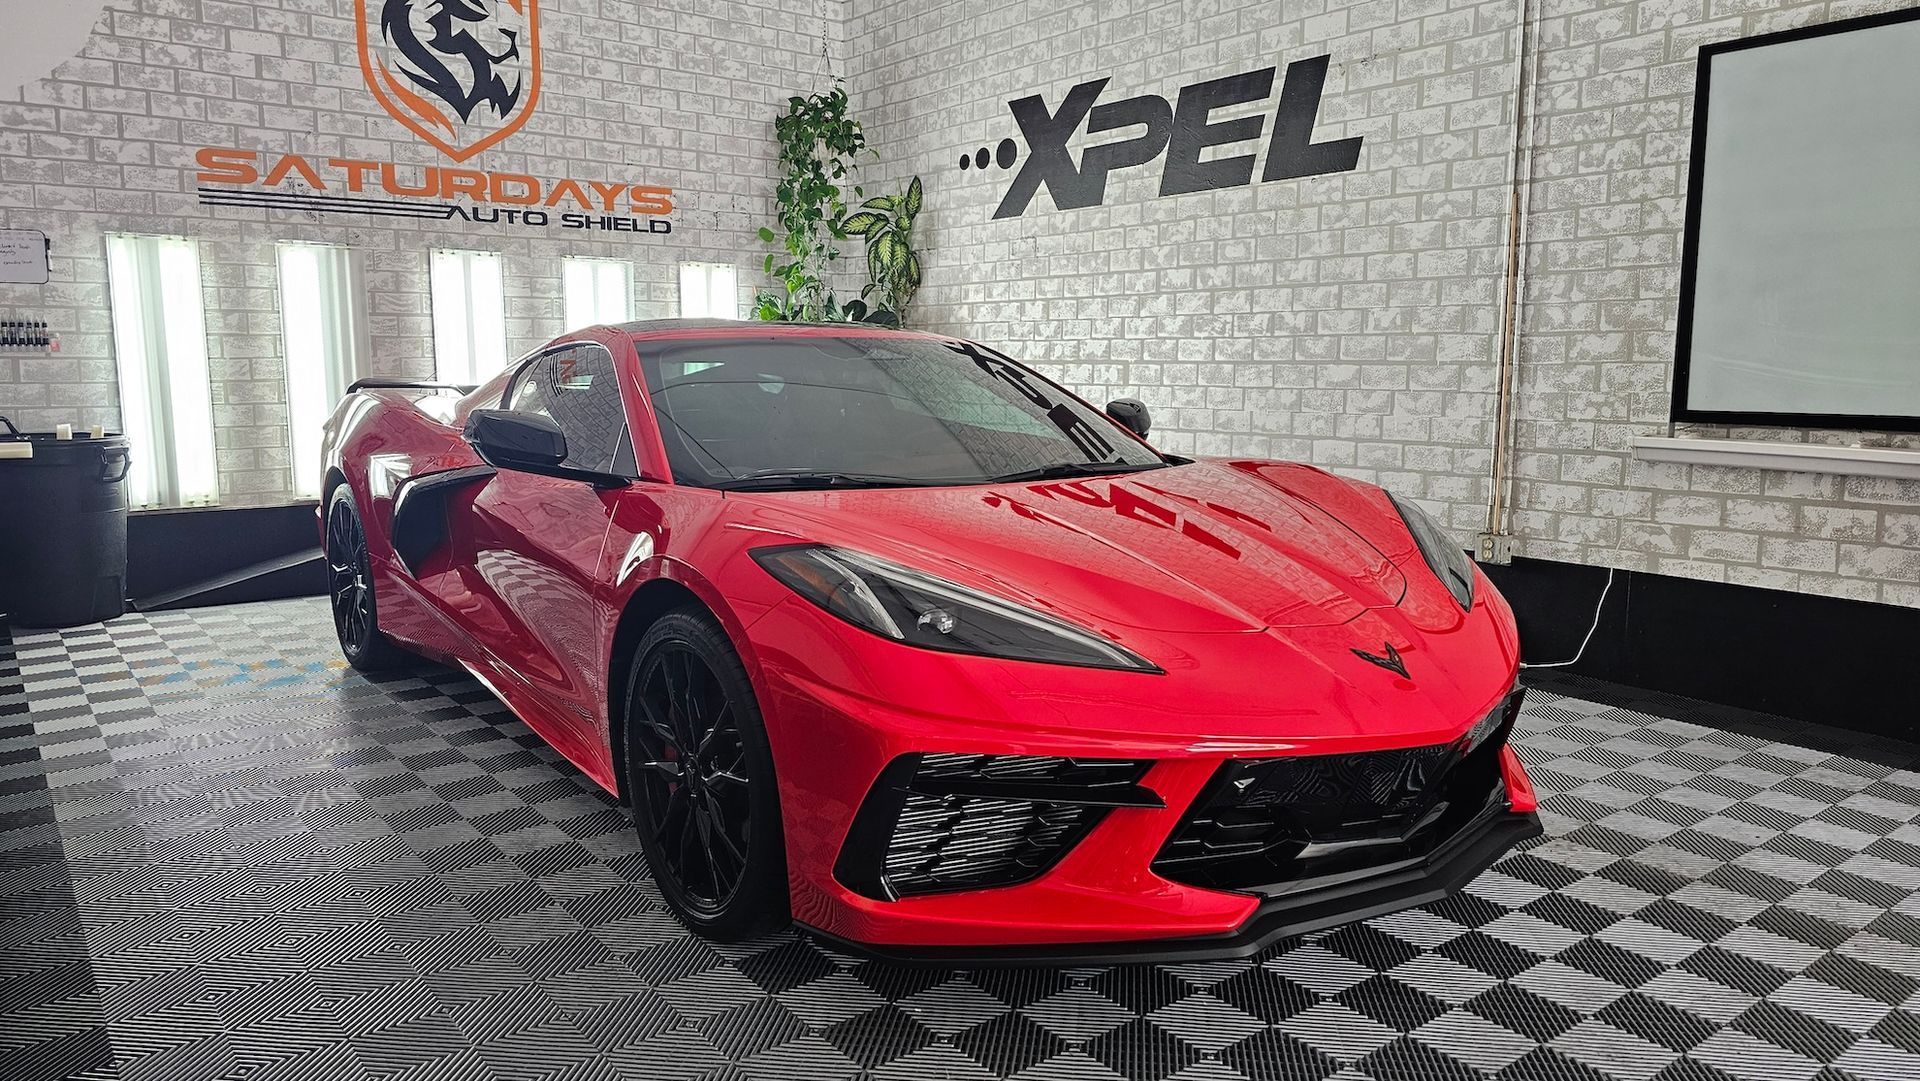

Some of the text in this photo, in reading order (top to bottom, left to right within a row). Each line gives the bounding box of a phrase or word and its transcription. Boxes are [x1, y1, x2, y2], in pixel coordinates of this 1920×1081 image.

[991, 53, 1365, 220] XPEL
[195, 147, 674, 215] SATURDAYS
[446, 204, 673, 235] AUTO SHIELD
